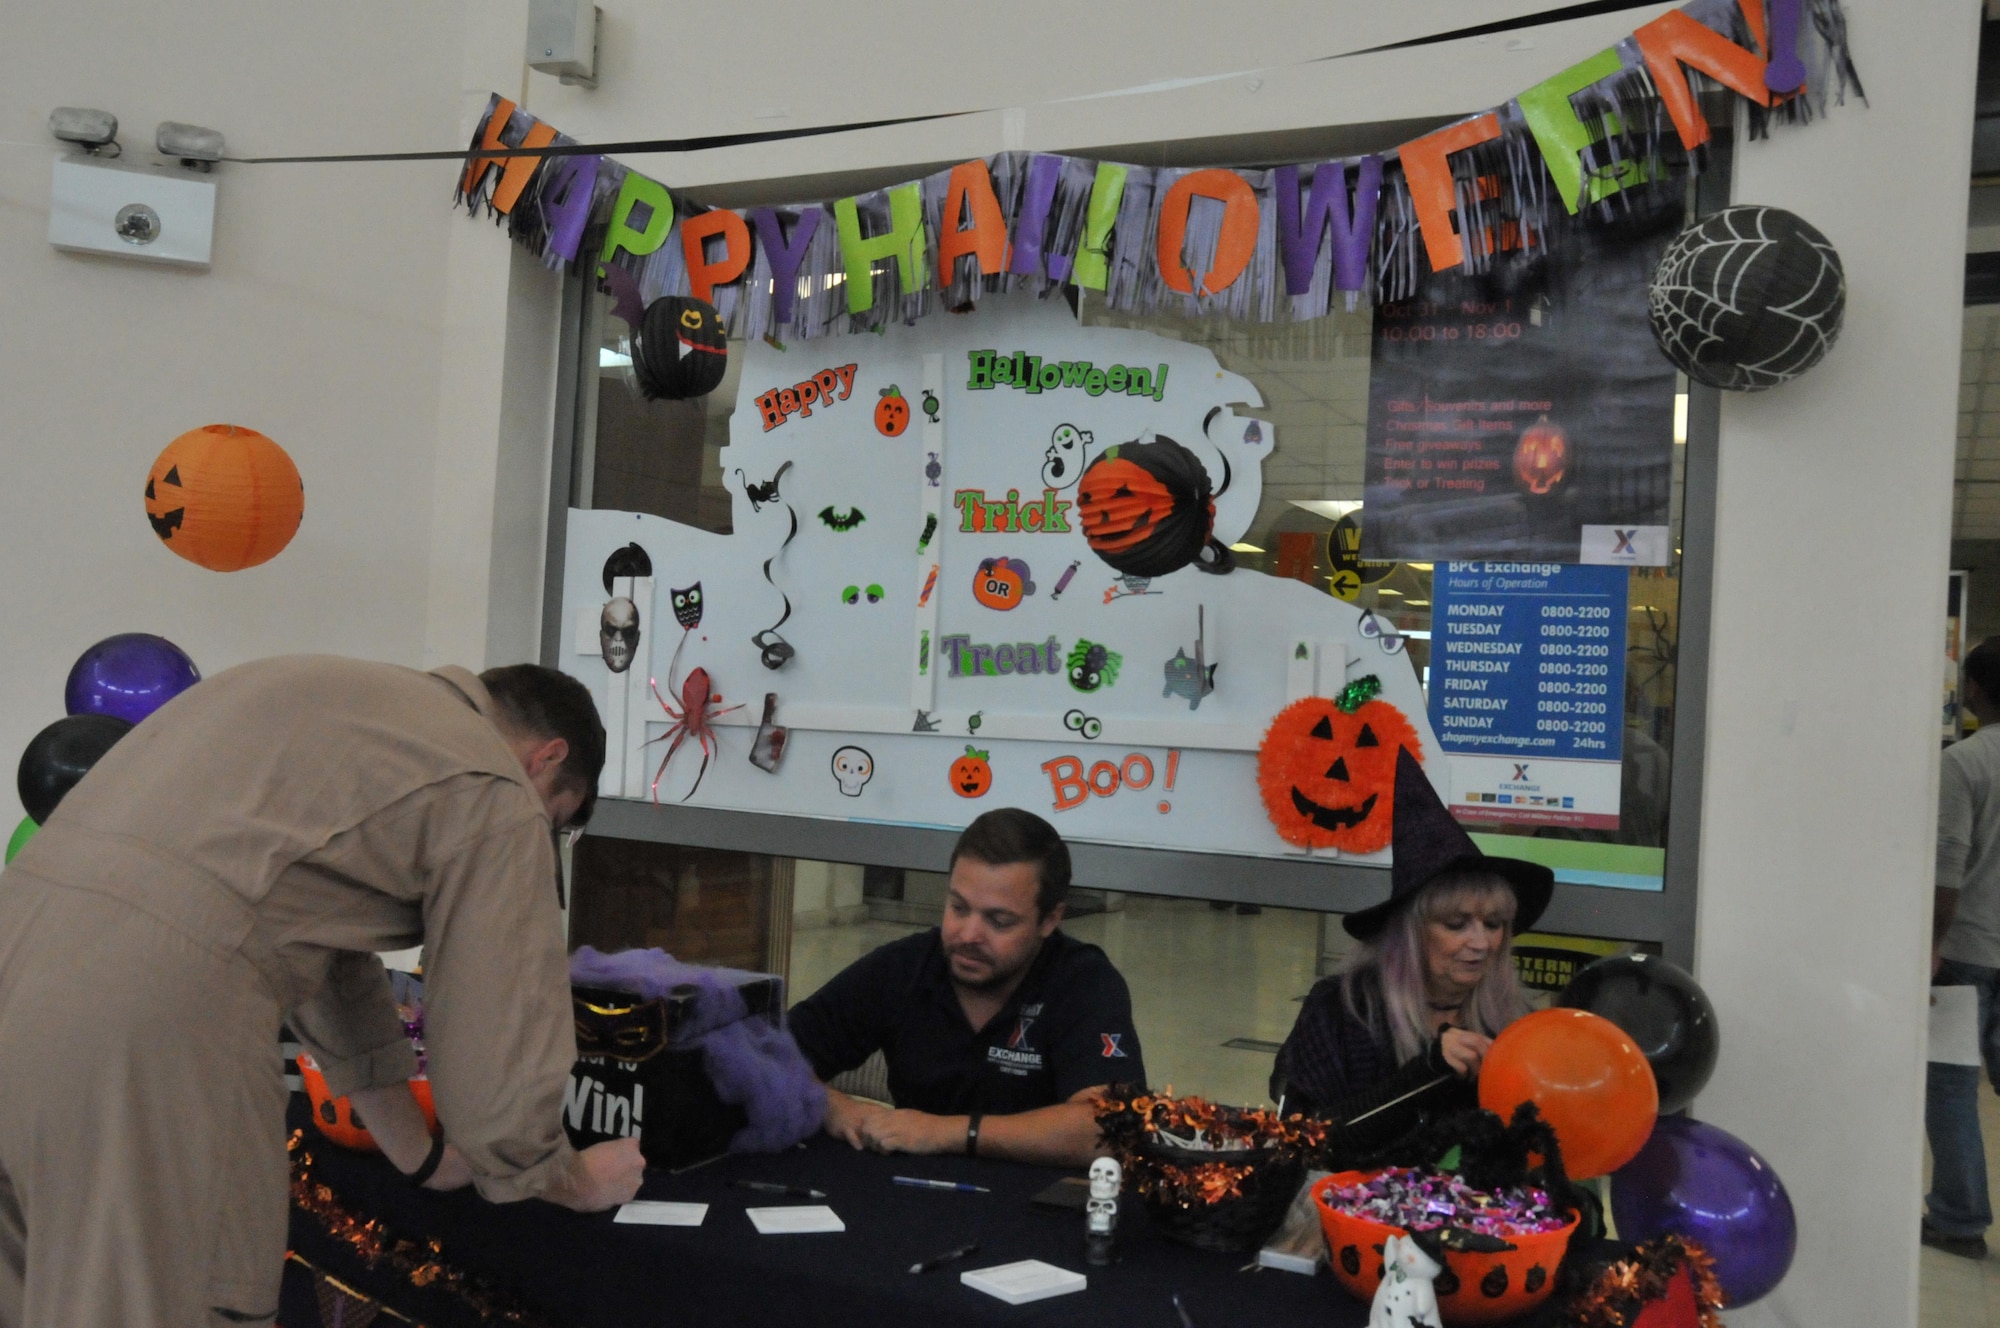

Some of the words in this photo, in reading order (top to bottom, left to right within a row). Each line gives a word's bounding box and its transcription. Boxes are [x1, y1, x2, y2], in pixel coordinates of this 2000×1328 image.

[462, 97, 822, 324] HAPPY
[966, 349, 1169, 401] Halloween!
[755, 363, 858, 432] Happy
[1490, 400, 1514, 411] and
[1518, 401, 1552, 411] more
[1384, 457, 1416, 469] Enter
[1421, 459, 1432, 469] to
[1437, 458, 1457, 469] win
[1462, 458, 1500, 471] prizes
[1417, 479, 1429, 489] or
[1436, 477, 1485, 493] Treating
[954, 488, 1073, 533] Trick
[1449, 562, 1479, 573] BPC
[1484, 563, 1562, 577] Exchange
[985, 579, 1011, 598] OR
[1449, 578, 1479, 589] Hours
[1482, 578, 1494, 591] of
[1496, 579, 1548, 592] Operation
[1447, 605, 1505, 617] MONDAY
[1541, 606, 1610, 618] 0800-2200
[1447, 623, 1502, 635] TUESDAY
[1540, 625, 1610, 637] 0800-2200
[941, 634, 1062, 678] Treat
[1446, 642, 1523, 655] WEDNESDAY
[1539, 644, 1609, 656] 0800-2200
[1446, 660, 1510, 673] THURSDAY
[1539, 663, 1608, 676] 0800-2200
[1445, 679, 1489, 692] FRIDAY
[1538, 682, 1608, 695] 0800-2200
[1443, 697, 1509, 711] SATURDAY
[1537, 701, 1607, 714] 0800-2200
[1443, 715, 1494, 729] SUNDAY
[1536, 719, 1606, 733] 0800-2200
[1441, 732, 1556, 748] shopmyexchange.com
[1573, 738, 1606, 749] 24hrs
[1041, 748, 1181, 813] Boo!
[1499, 784, 1541, 792] EXCHANGE
[988, 1046, 1042, 1065] EXCHANGE
